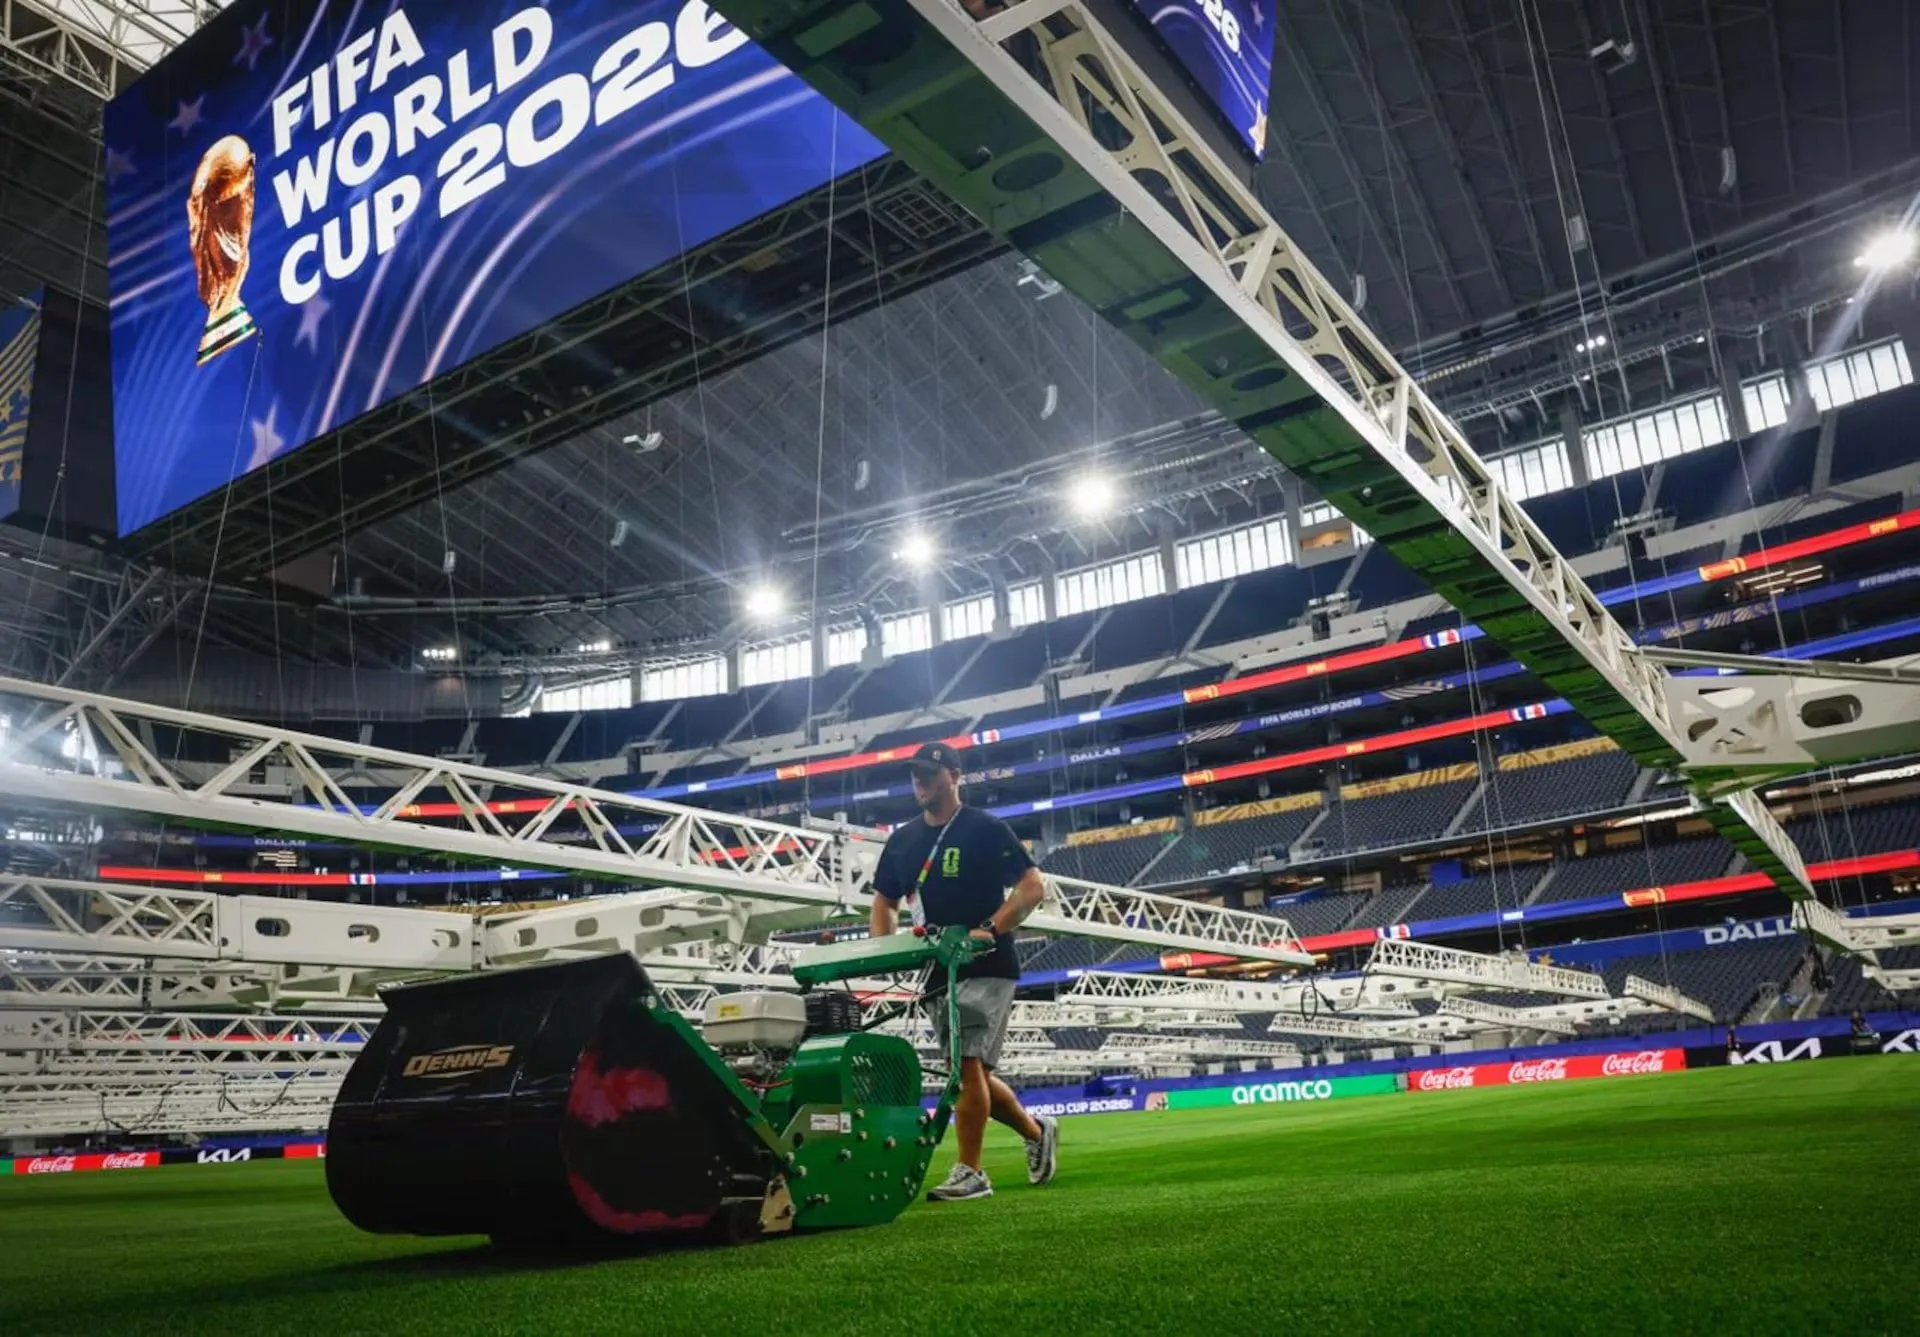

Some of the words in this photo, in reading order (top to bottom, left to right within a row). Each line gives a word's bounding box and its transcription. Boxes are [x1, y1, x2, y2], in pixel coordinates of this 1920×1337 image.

[1195, 0, 1241, 53] 26
[272, 9, 425, 157] FIFA
[273, 6, 554, 228] WORLD
[278, 175, 420, 305] CUP
[436, 0, 751, 219] 2026
[1260, 714, 1280, 727] FIFA
[1280, 708, 1311, 721] WORLD
[1312, 704, 1330, 716] CUP
[1070, 747, 1121, 763] DALLAS
[1704, 918, 1797, 945] DALL
[402, 1045, 515, 1077] DENNIS
[1232, 1080, 1333, 1104] aramco
[1025, 1103, 1065, 1116] WORLD
[1066, 1101, 1089, 1113] CUP
[1089, 1099, 1131, 1112] 2026
[197, 1147, 251, 1164] KIA
